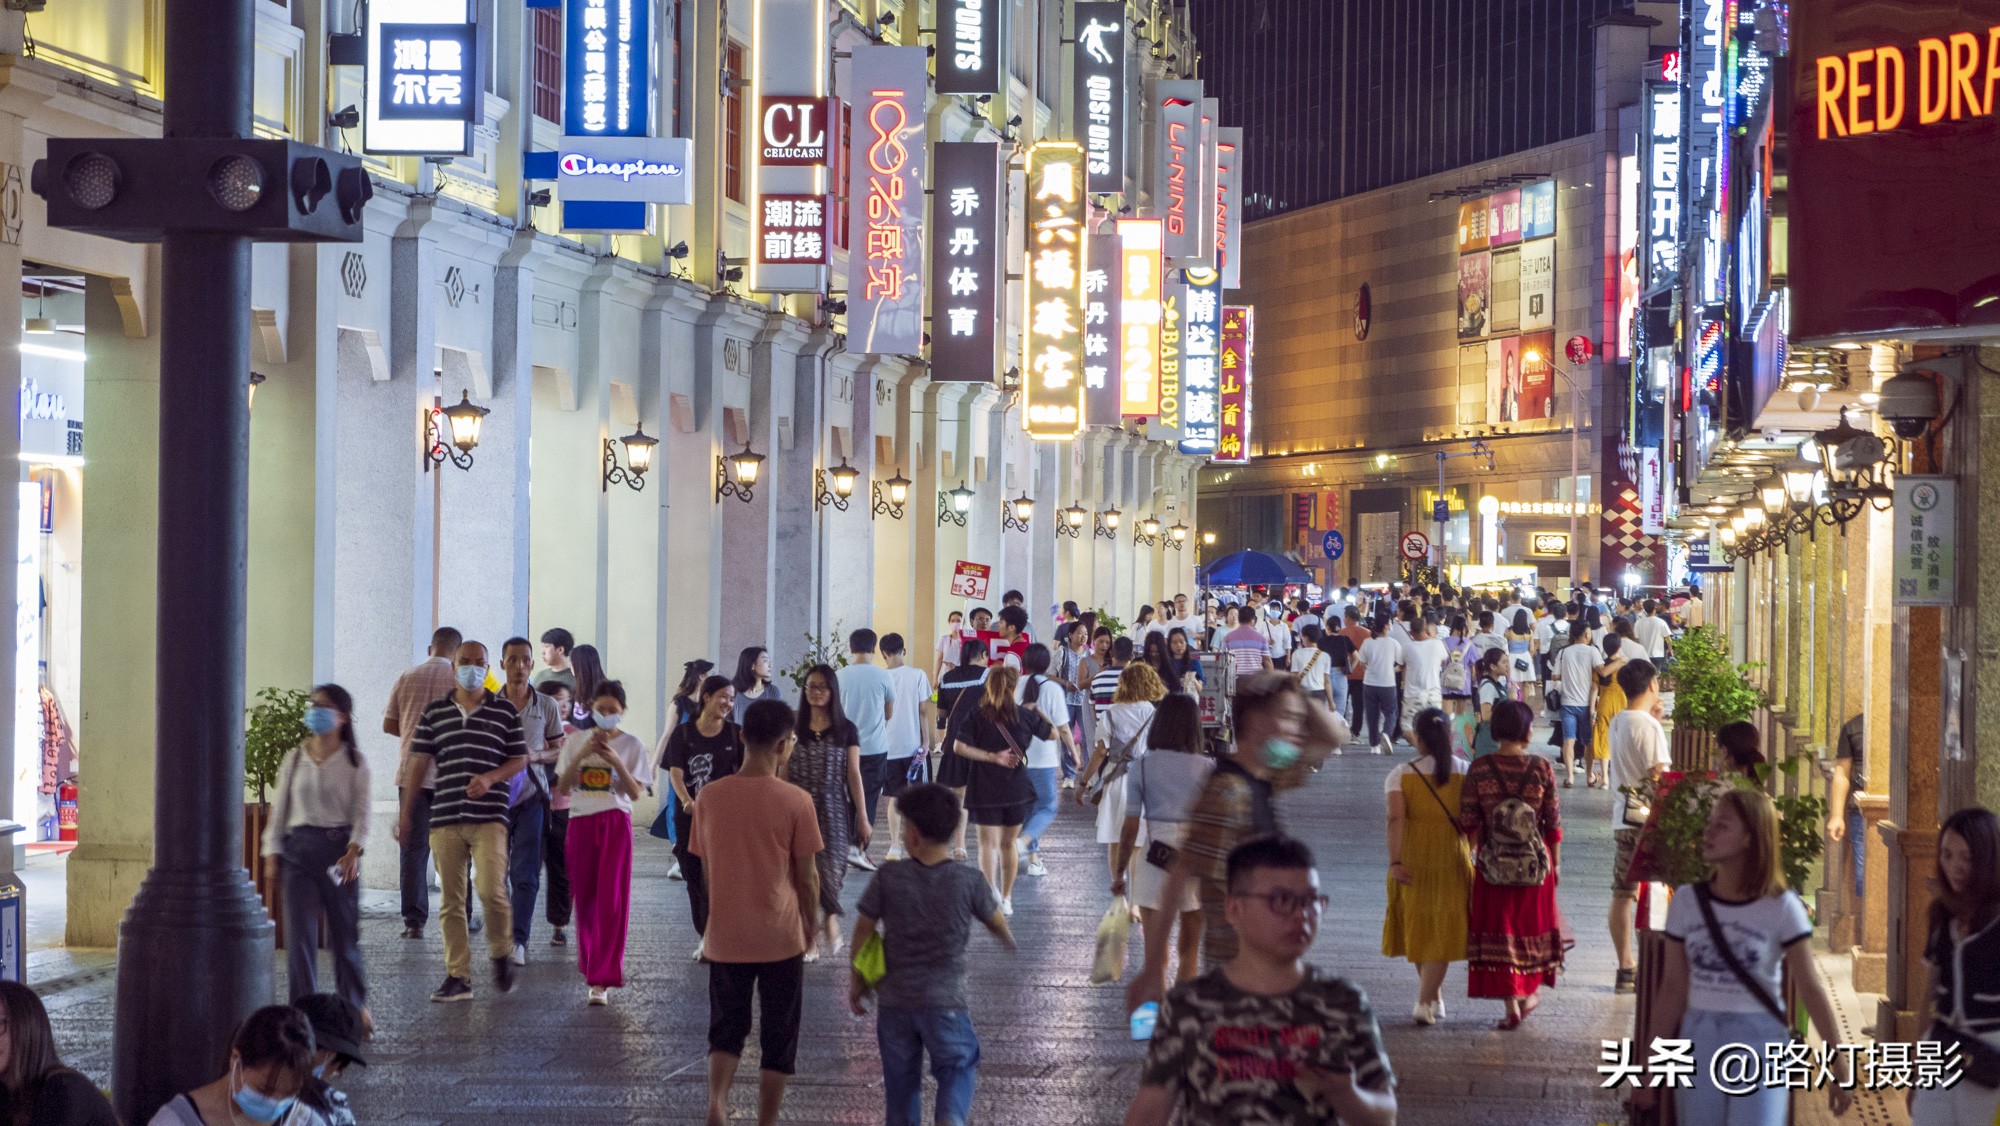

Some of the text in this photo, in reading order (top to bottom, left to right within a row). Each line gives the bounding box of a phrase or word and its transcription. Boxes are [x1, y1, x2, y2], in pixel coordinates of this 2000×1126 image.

[393, 39, 462, 71] 鸿星
[393, 74, 462, 105] 尔克
[1816, 46, 1905, 140] RED
[763, 103, 824, 147] CL
[764, 148, 823, 158] CELUCASN
[1168, 122, 1187, 235] LI-NING
[764, 200, 823, 227] 潮流
[764, 232, 823, 259] 前线
[948, 187, 979, 336] 乔丹体育
[1085, 269, 1109, 389] 乔丹体育
[1160, 329, 1180, 429] BABIBOY
[1221, 346, 1244, 458] 金山首饰
[964, 578, 977, 595] 3
